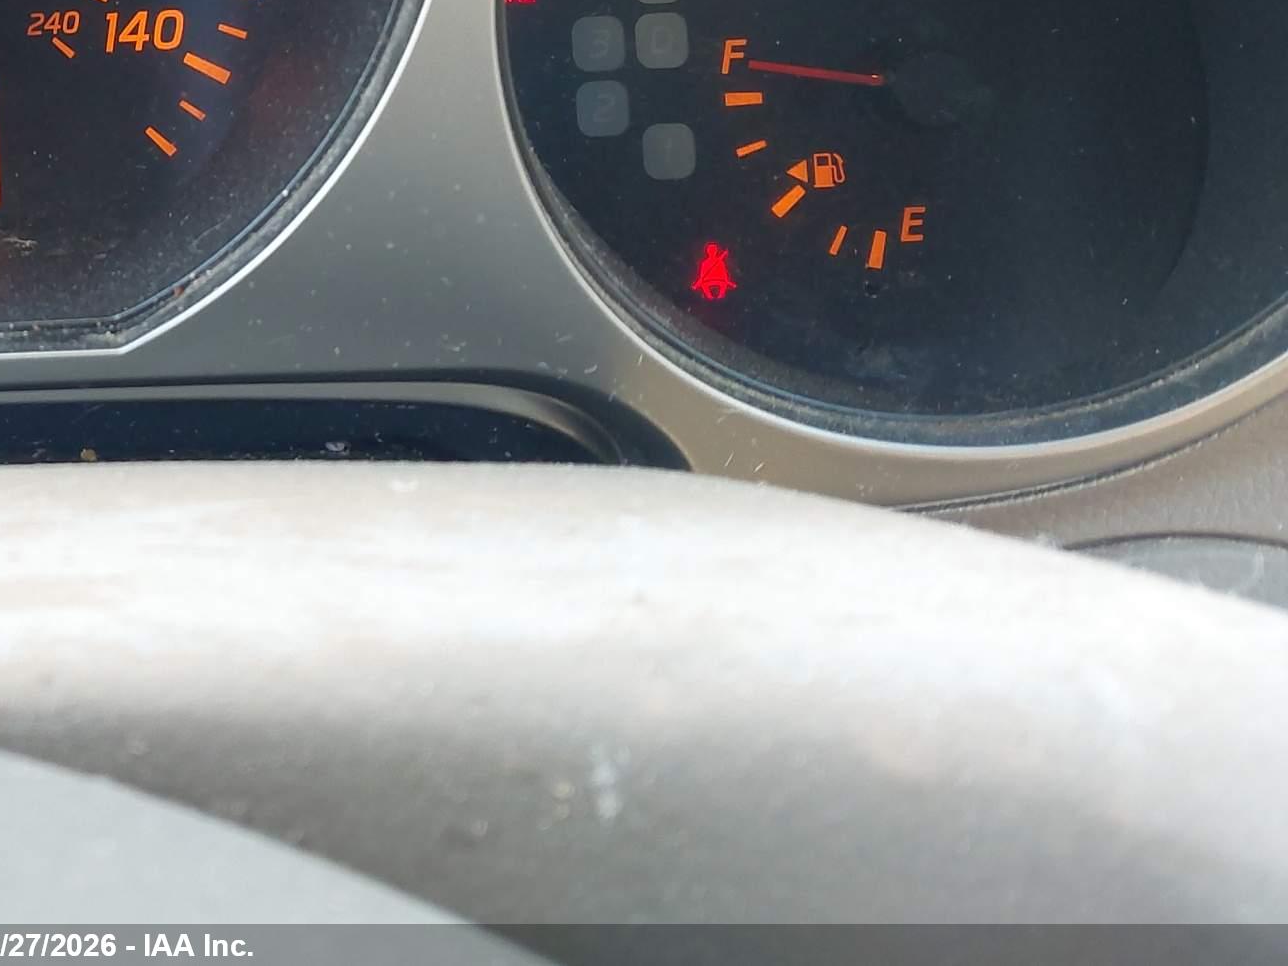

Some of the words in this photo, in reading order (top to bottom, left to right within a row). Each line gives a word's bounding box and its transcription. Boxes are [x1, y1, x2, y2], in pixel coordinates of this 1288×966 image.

[27, 9, 81, 36] 240
[105, 9, 185, 54] 140
[721, 38, 746, 75] F
[900, 206, 926, 242] E
